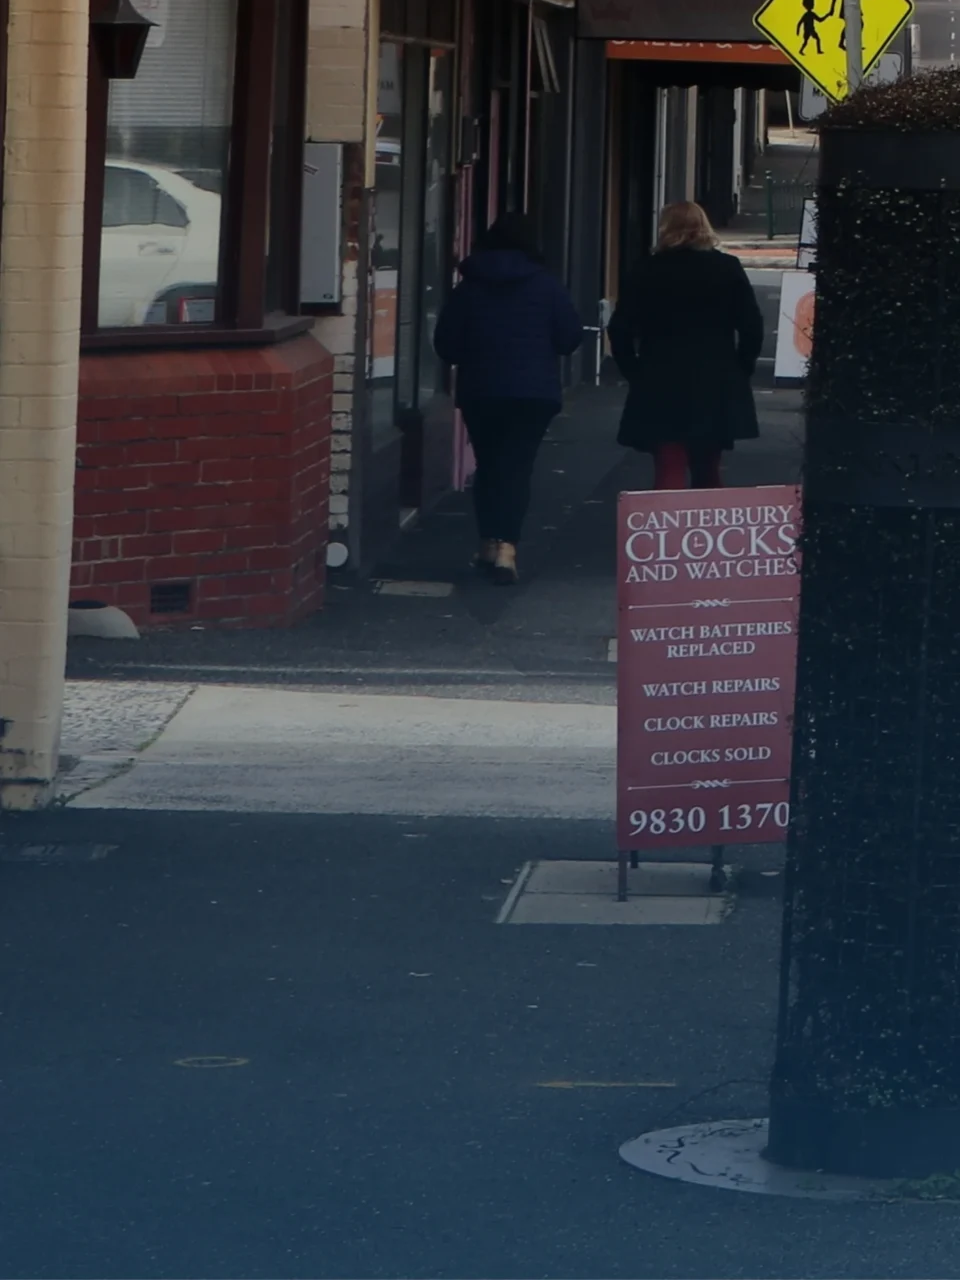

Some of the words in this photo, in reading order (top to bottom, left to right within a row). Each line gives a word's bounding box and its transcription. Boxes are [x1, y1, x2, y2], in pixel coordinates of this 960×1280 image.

[627, 505, 794, 531] CANTERBURY
[625, 523, 796, 562] CLOCKS
[625, 564, 677, 583] AND
[684, 557, 797, 580] WATCHES
[630, 626, 694, 642] WATCH
[699, 621, 792, 639] BATTERIES
[666, 641, 755, 658] REPLACED
[642, 681, 707, 697] WATCH
[711, 677, 780, 694] REPAIRS
[644, 715, 705, 732] CLOCK
[709, 711, 778, 728] REPAIRS
[651, 748, 720, 766] CLOCKS
[724, 746, 771, 762] SOLD
[629, 806, 705, 836] 9830
[718, 801, 790, 831] 1370
